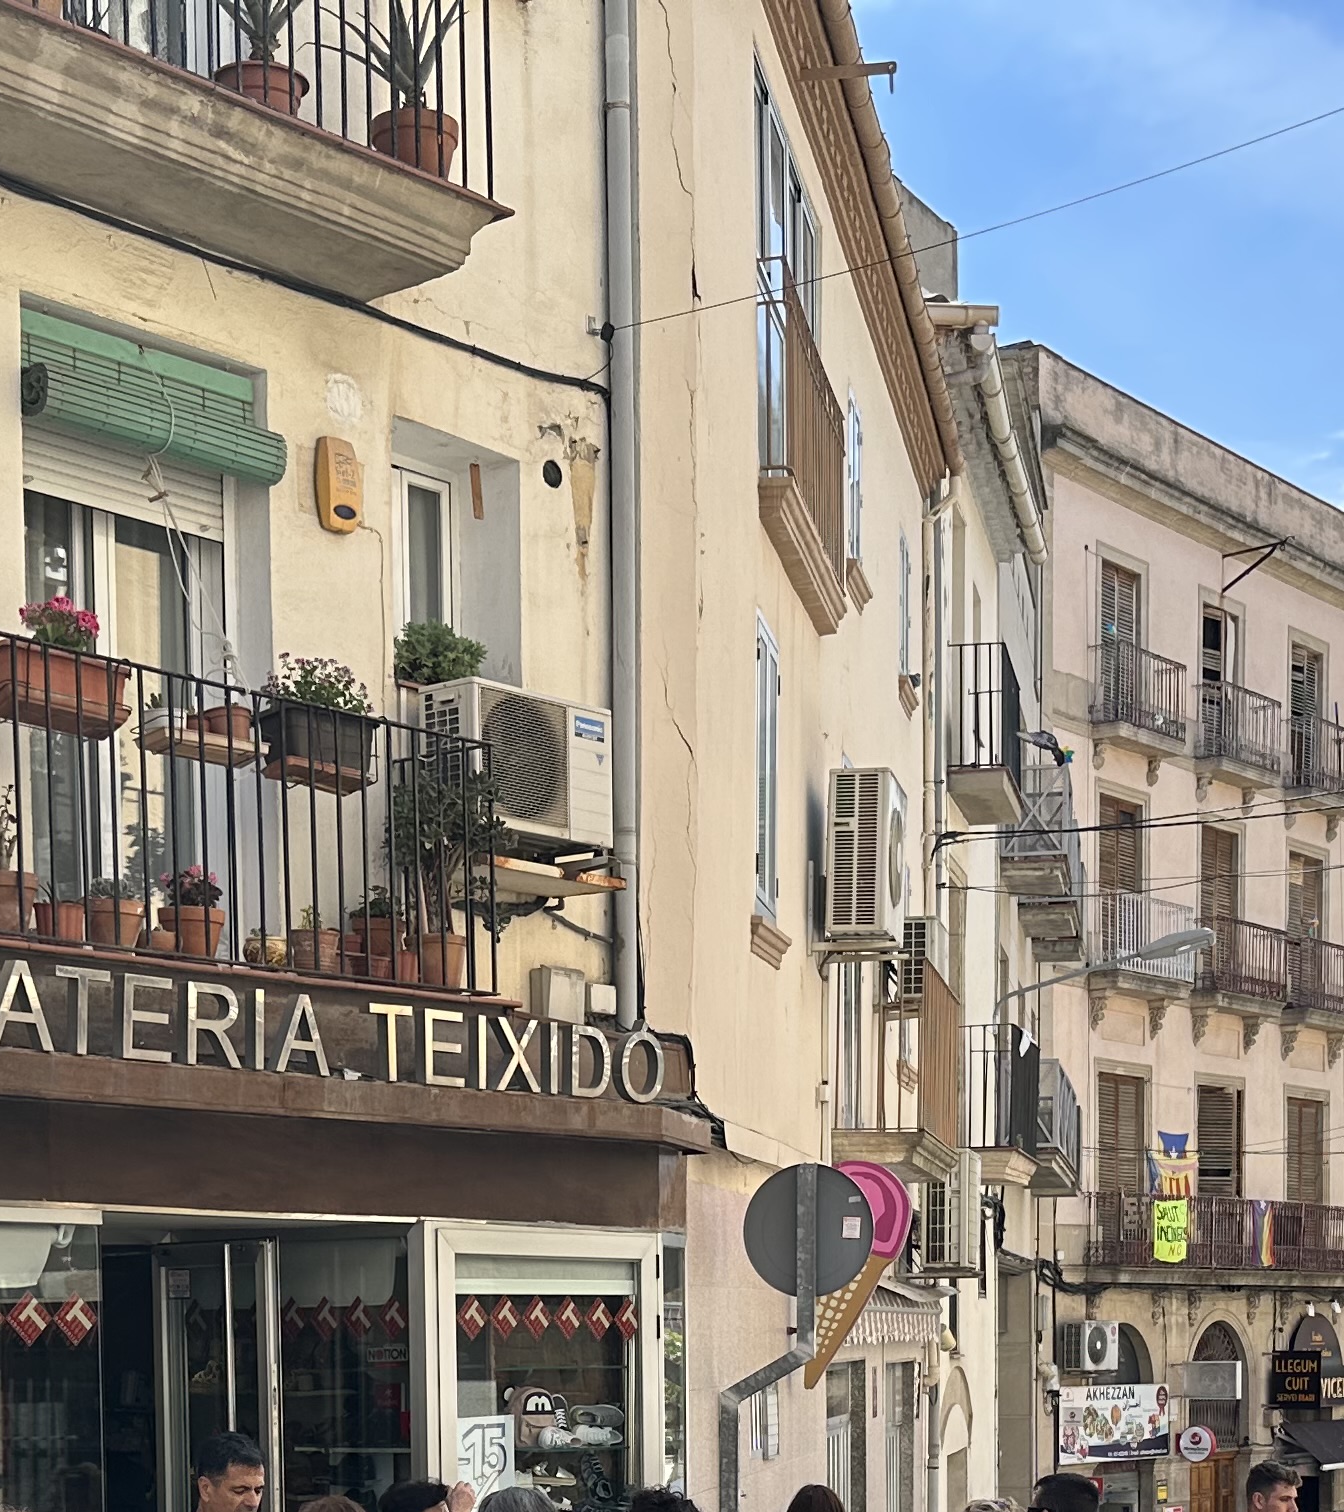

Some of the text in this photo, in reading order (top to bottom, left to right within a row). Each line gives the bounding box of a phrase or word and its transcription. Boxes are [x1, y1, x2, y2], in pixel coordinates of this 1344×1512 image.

[368, 1002, 665, 1104] TEIXIDÓ
[1275, 1359, 1317, 1372] LLEGUM
[1285, 1376, 1309, 1390] CUIT
[1086, 1386, 1135, 1401] AKHEZZAN
